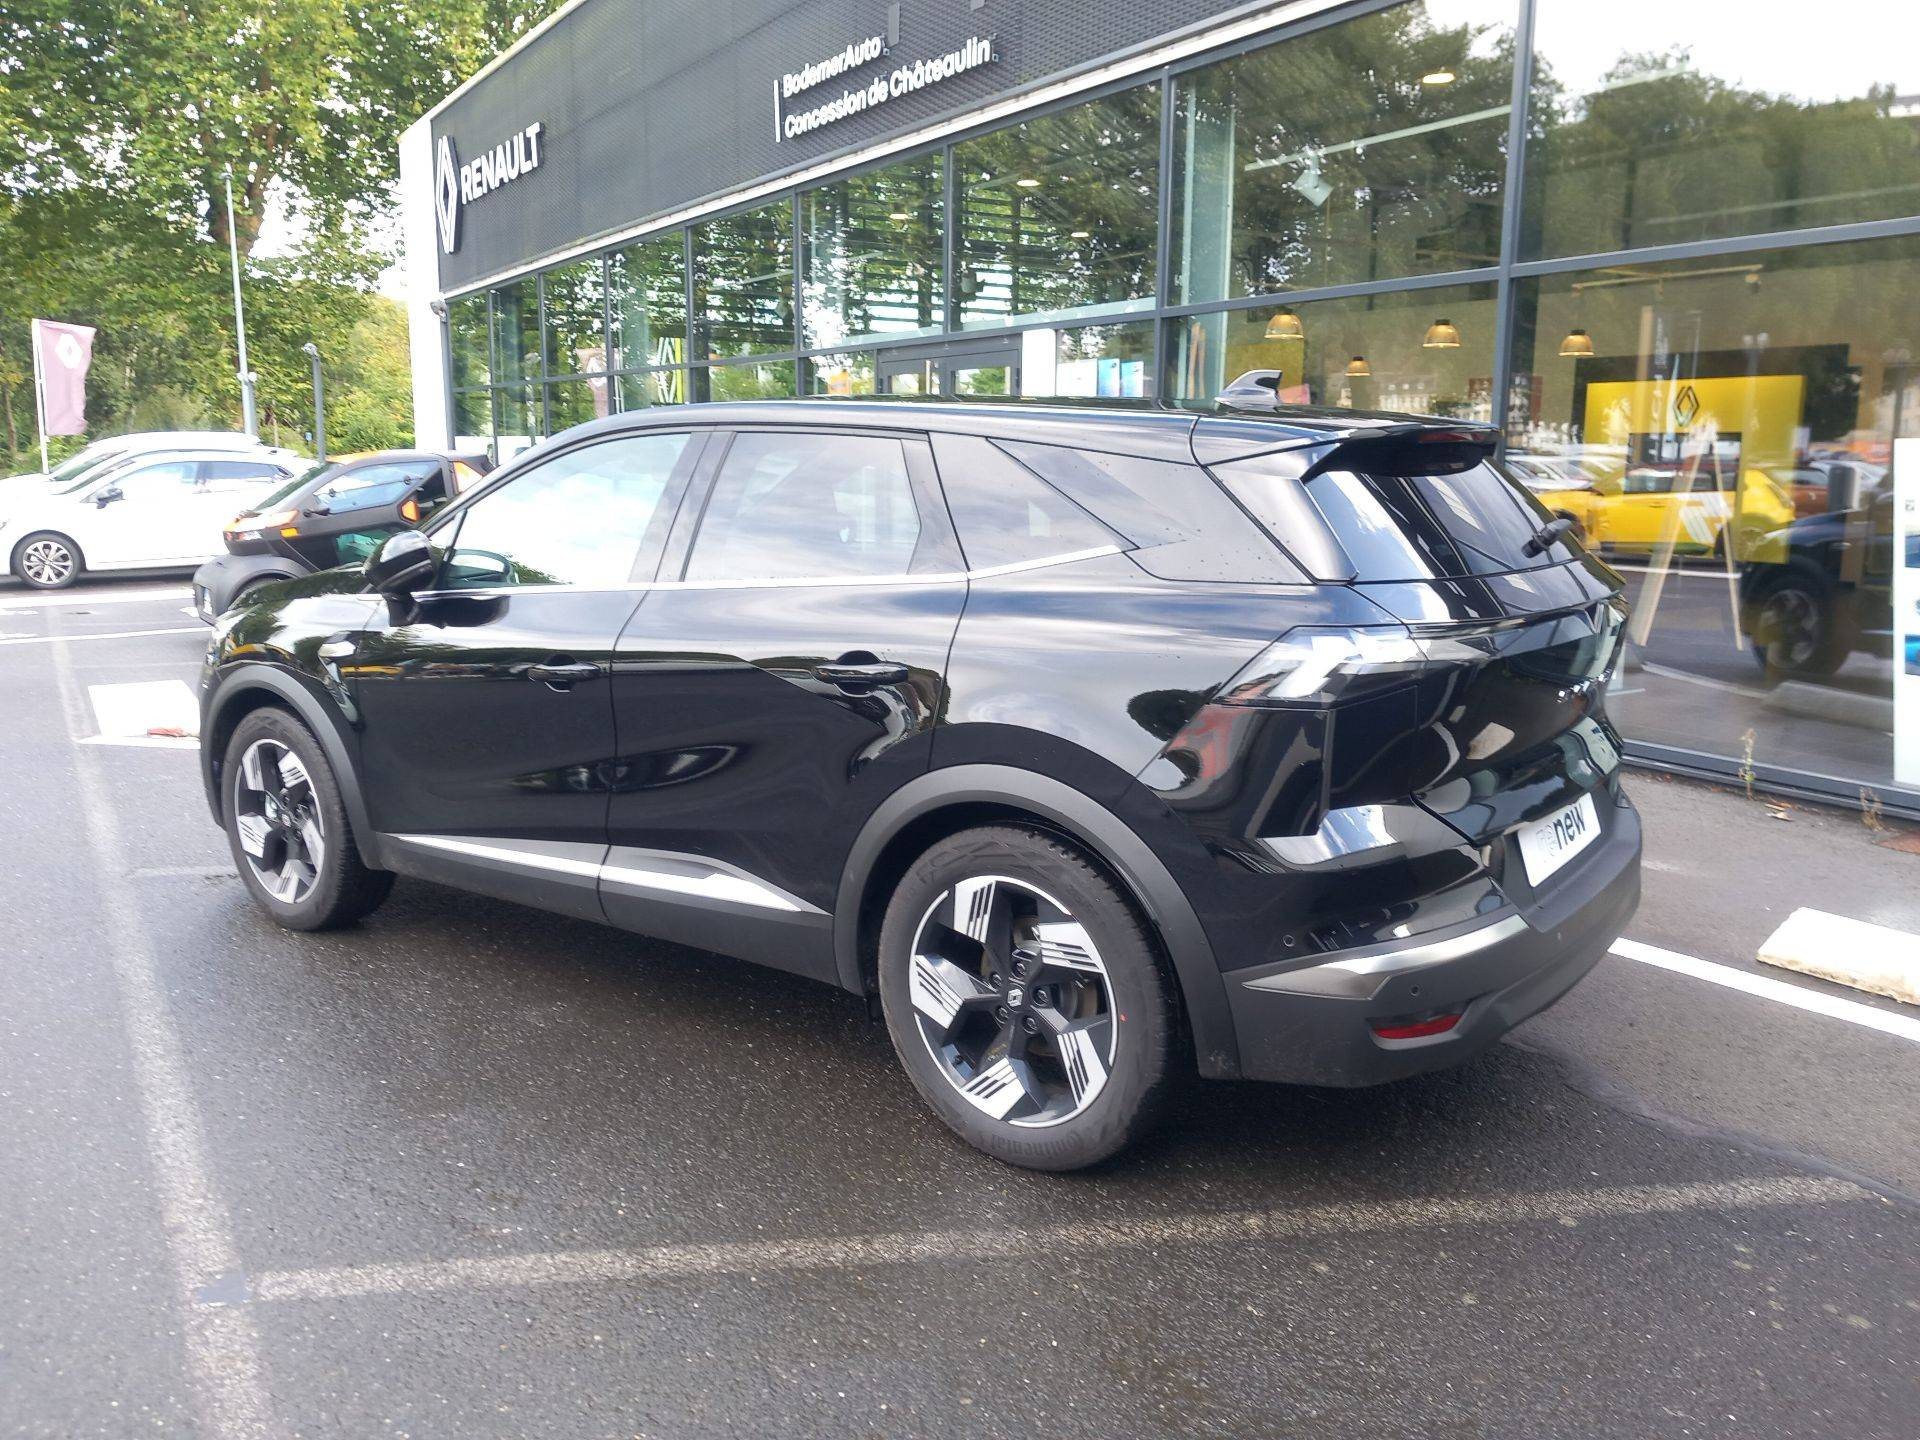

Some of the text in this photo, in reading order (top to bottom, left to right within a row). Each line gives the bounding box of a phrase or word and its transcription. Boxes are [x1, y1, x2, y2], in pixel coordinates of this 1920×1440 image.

[784, 37, 991, 138] Concession de Châteaulin
[461, 122, 540, 205] RENAULT
